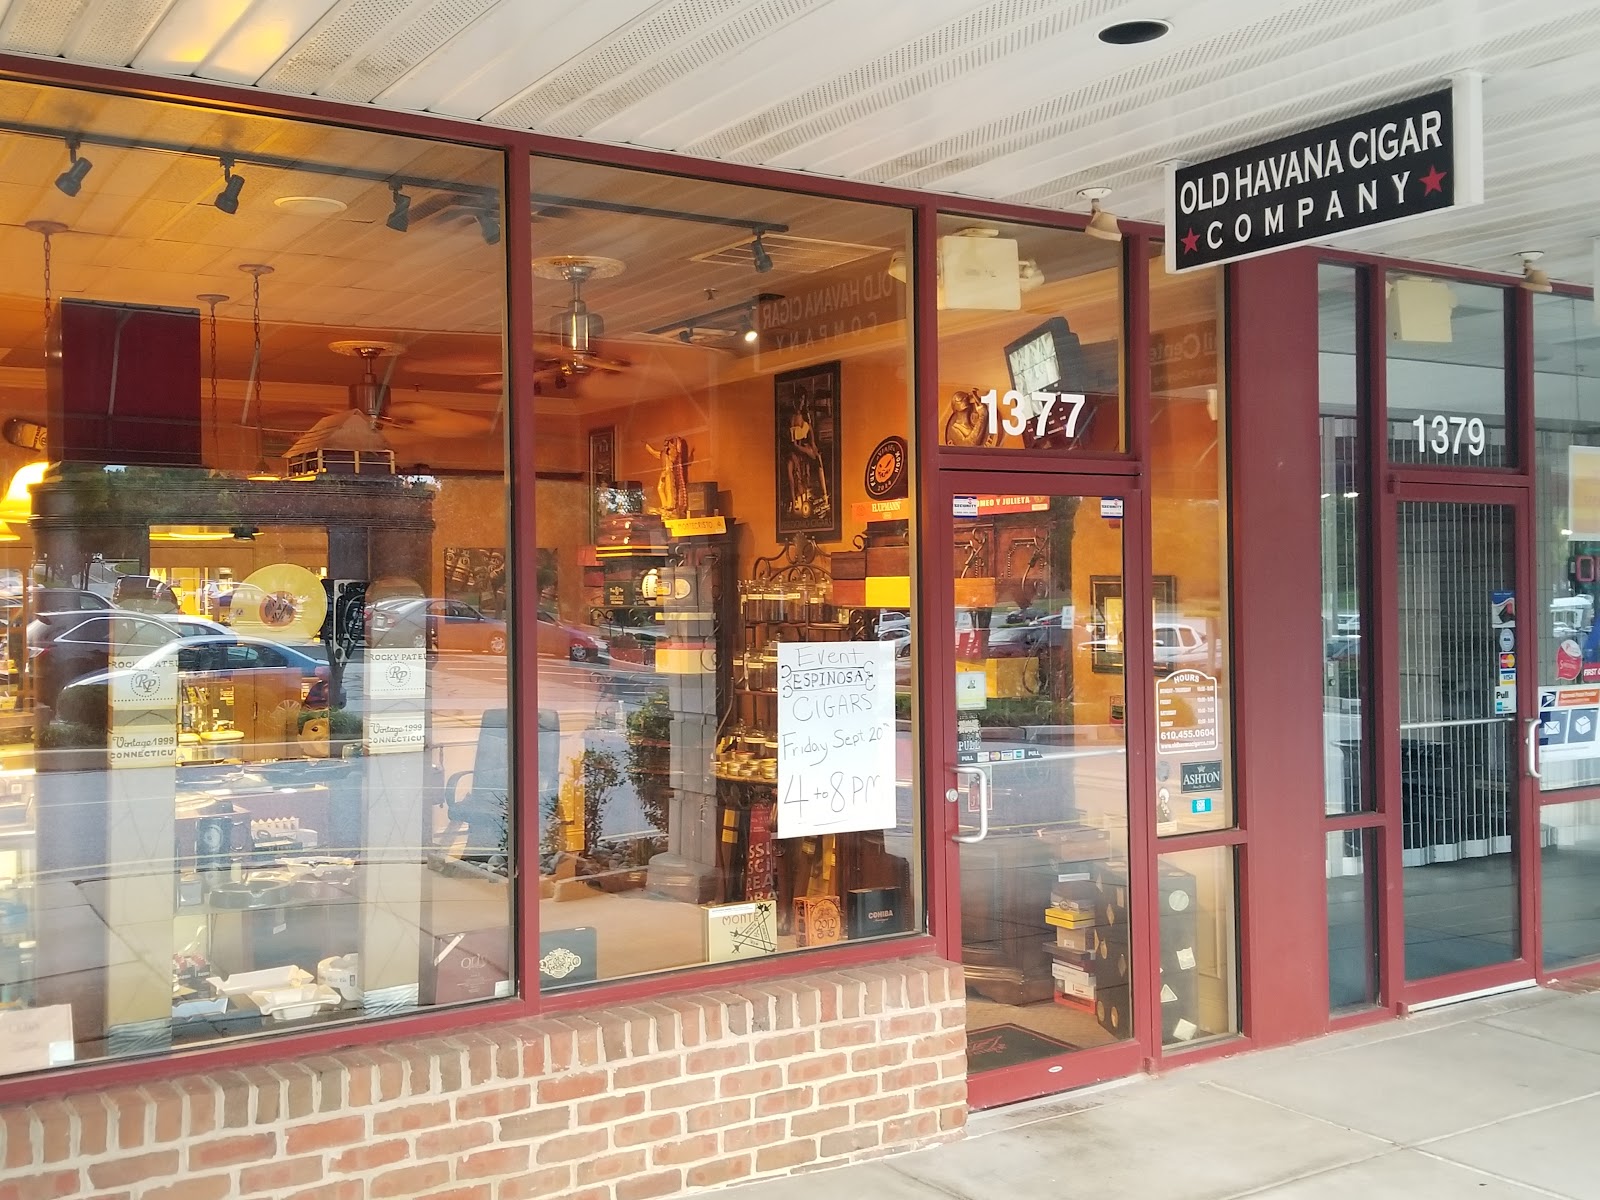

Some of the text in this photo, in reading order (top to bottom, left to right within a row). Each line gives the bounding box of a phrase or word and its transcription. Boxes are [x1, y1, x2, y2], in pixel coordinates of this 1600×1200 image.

[1180, 110, 1443, 215] OLD HAVANA CIGAR
[1206, 171, 1411, 249] COMPANY
[981, 389, 1086, 437] 1377
[1413, 415, 1485, 456] 1379
[1002, 497, 1030, 506] JULIETA
[370, 653, 400, 661] ROCKY
[795, 646, 864, 667] Event
[1174, 674, 1200, 684] HOURS
[1584, 668, 1597, 677] FIRST
[793, 670, 864, 690] ESPINOSA
[405, 724, 422, 732] 1999
[1160, 728, 1215, 740] 610.455.0604
[151, 736, 174, 746] 1999
[782, 732, 828, 766] Friday
[832, 729, 865, 749] Sept
[110, 749, 176, 759] CONNECTICU
[1183, 771, 1220, 785] ASHTON
[784, 774, 809, 817] 4
[814, 787, 829, 799] to
[831, 771, 845, 812] 8
[722, 912, 759, 926] MONTE
[868, 910, 893, 919] COHIBA
[814, 918, 837, 931] 2012
